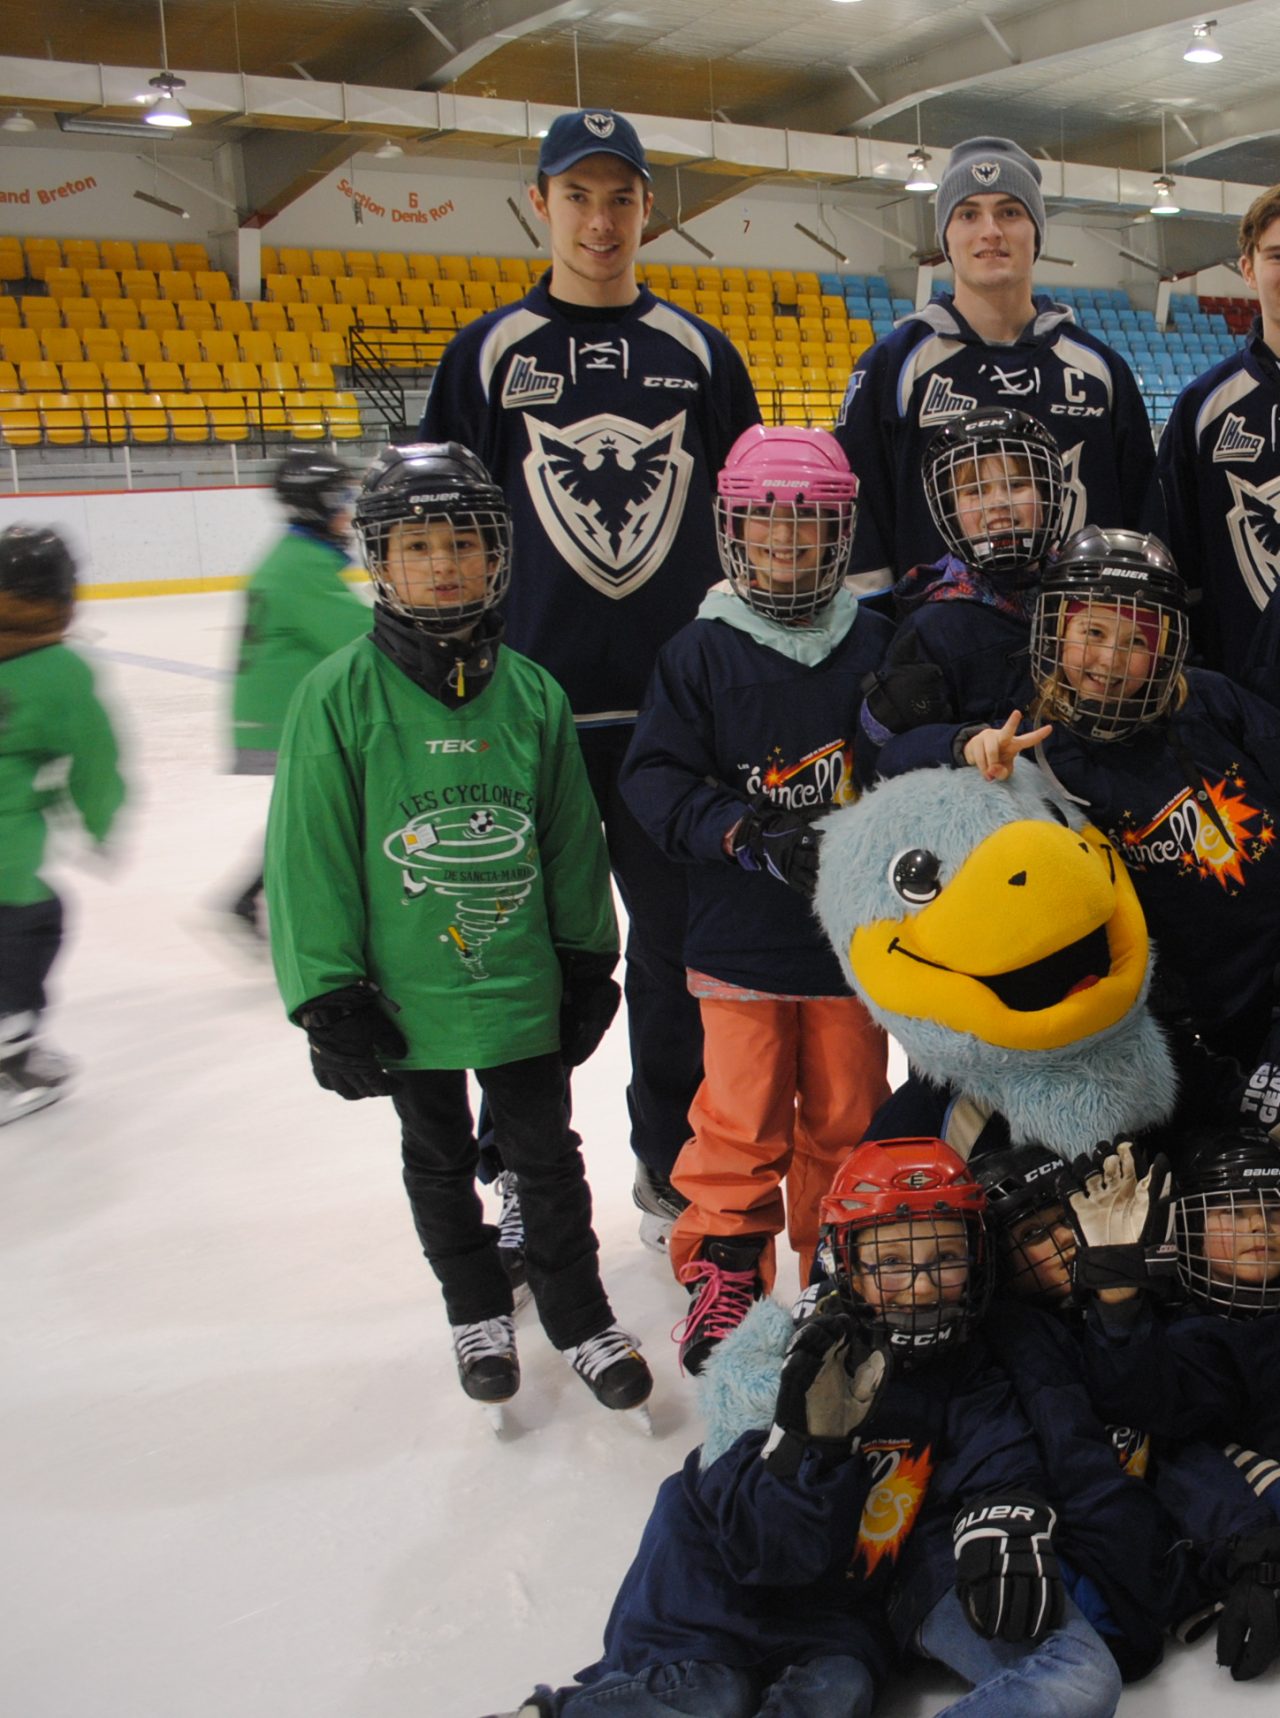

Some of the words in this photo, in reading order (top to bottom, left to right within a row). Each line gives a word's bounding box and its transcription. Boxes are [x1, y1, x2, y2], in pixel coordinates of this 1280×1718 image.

[37, 176, 97, 204] Breton
[337, 178, 386, 217] Section
[391, 209, 428, 223] Denis
[429, 199, 455, 221] Roy
[408, 192, 418, 208] 6
[743, 219, 751, 234] 7
[642, 376, 699, 391] CCM
[1063, 367, 1087, 403] C
[1050, 403, 1105, 417] CCM
[965, 418, 1005, 431] CCM
[425, 739, 478, 754] TEK
[399, 790, 438, 820] LES
[442, 783, 535, 815] CYCLONES
[444, 869, 457, 881] DE
[1024, 1159, 1065, 1183] CCM
[890, 1327, 953, 1346] CCM
[953, 1505, 1035, 1542] AUER
